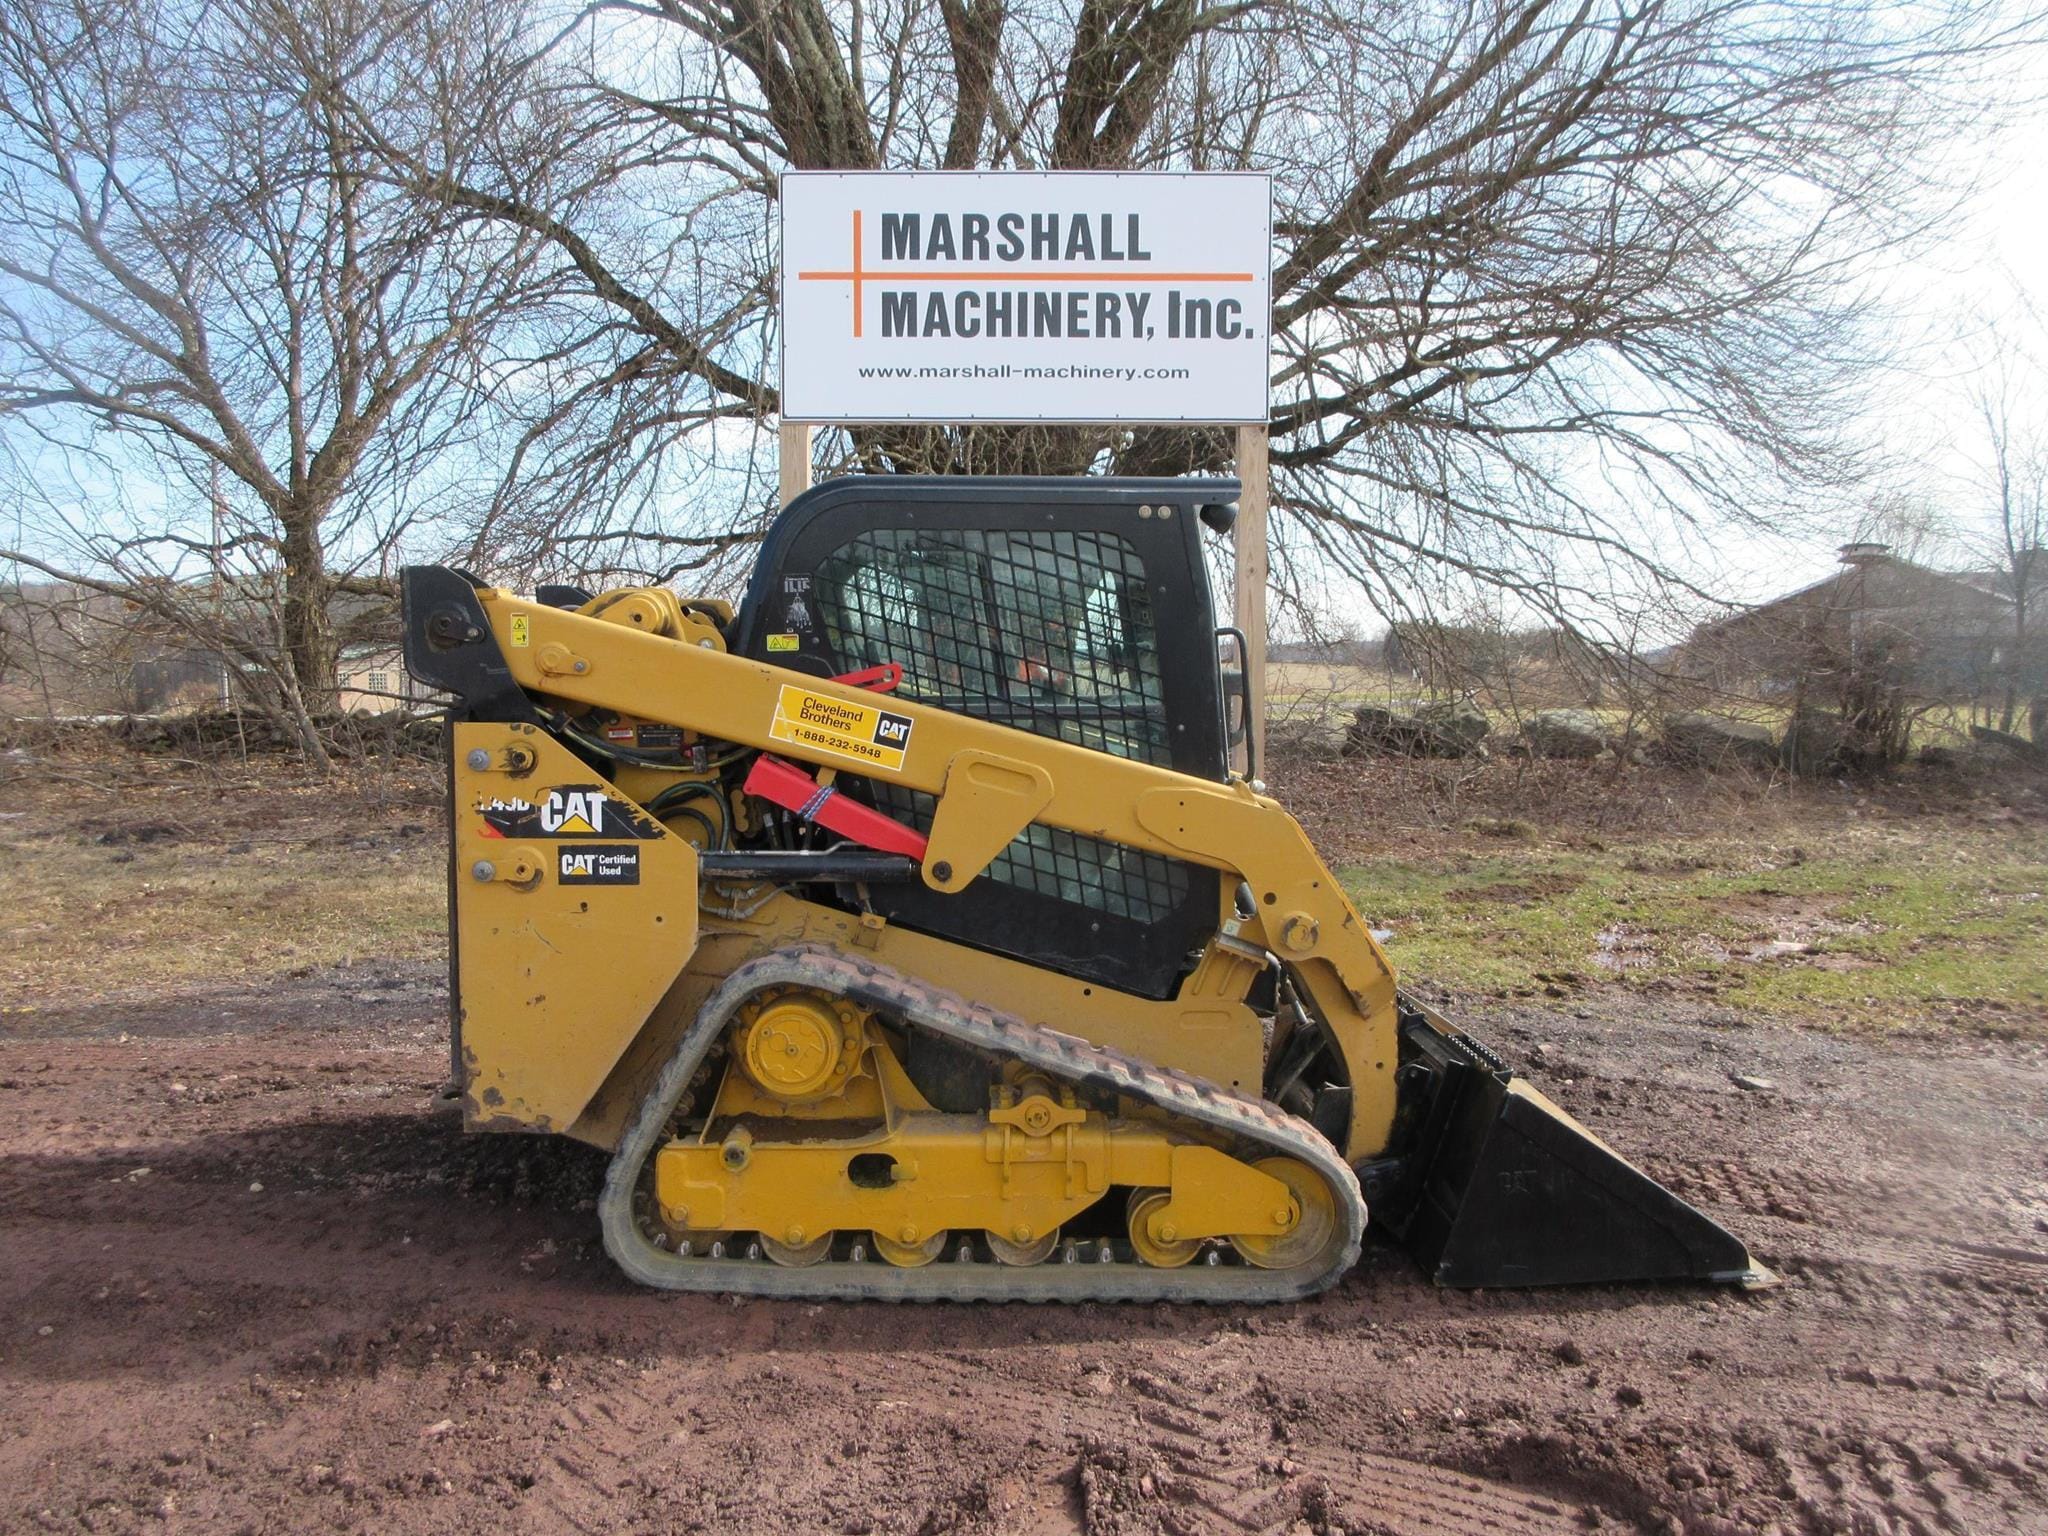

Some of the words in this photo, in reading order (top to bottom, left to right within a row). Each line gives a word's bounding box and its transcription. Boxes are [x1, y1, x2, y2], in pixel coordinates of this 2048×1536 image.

[881, 213, 1151, 261] MARSHALL
[881, 291, 1154, 341] MACHINERY,
[1168, 290, 1254, 340] Inc.
[858, 364, 1190, 381] www.marshall-machinery.com
[799, 707, 852, 731] Brothers
[802, 696, 864, 722] Cleveland
[879, 720, 909, 741] CAT
[794, 728, 882, 759] 1-888-232-5948
[540, 791, 608, 833] CAT
[561, 854, 597, 876] CAT
[599, 854, 636, 865] Certified
[599, 865, 621, 876] Used
